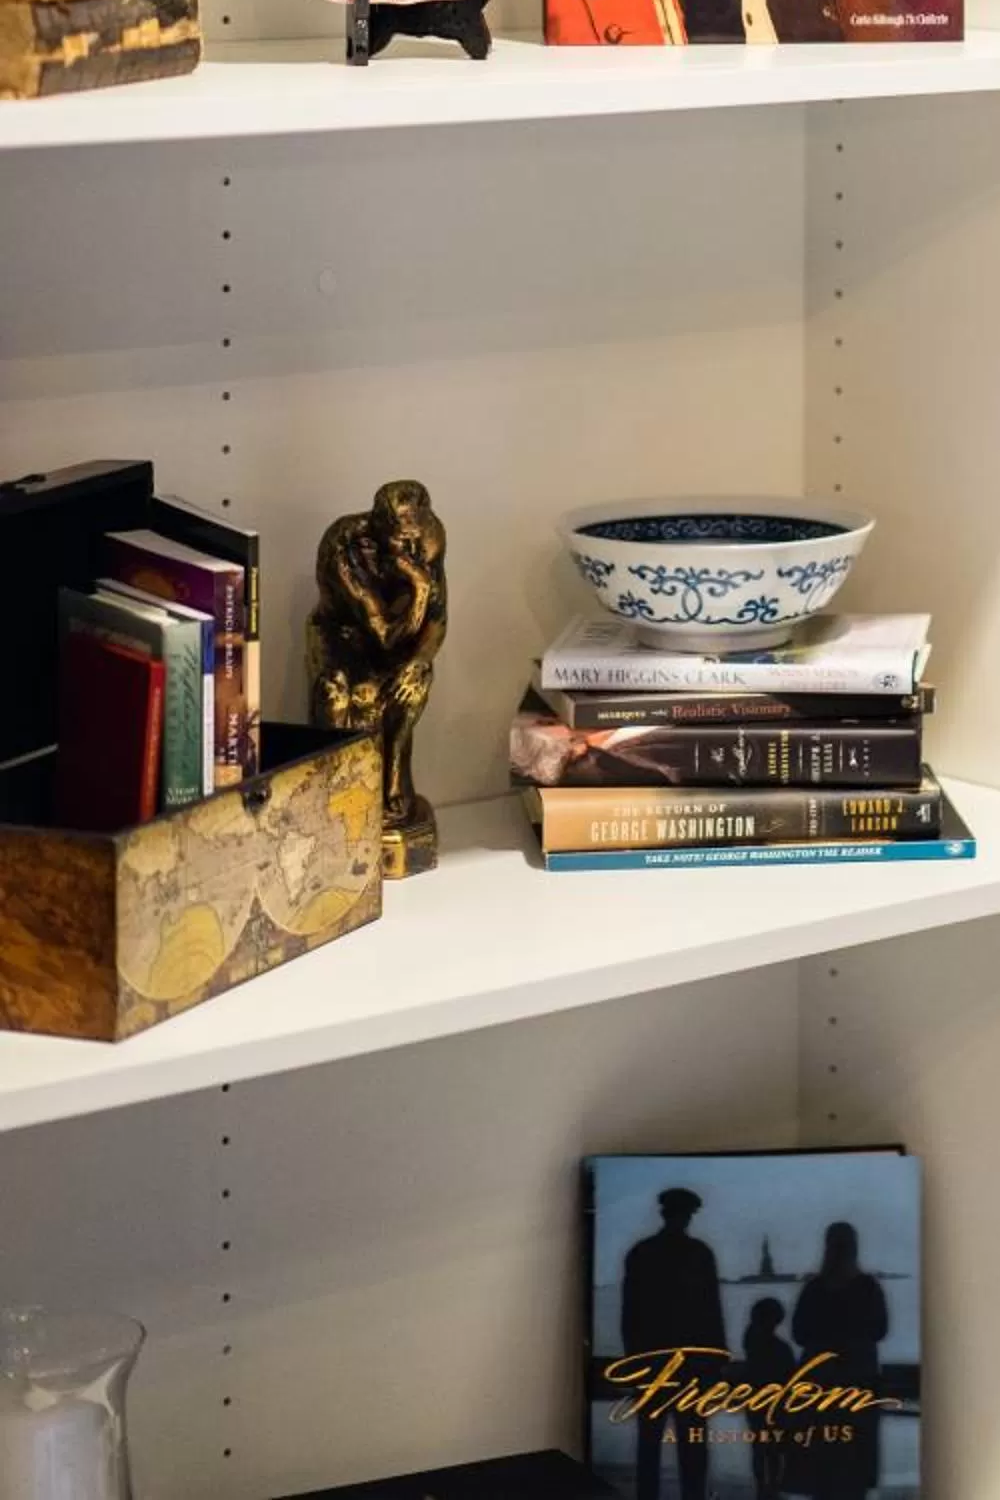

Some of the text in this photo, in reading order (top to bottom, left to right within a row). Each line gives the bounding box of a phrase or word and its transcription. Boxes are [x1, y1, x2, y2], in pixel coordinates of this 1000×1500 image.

[554, 666, 747, 686] MARY HIGGINS CLARK
[671, 704, 727, 719] Realistic
[612, 802, 728, 817] THE RETURN OF
[591, 815, 756, 843] GEORGE WASHINGTON
[644, 853, 671, 865] TAKE
[705, 850, 749, 862] GEORGE
[749, 848, 816, 861] WASHINGTON
[818, 847, 840, 858] THE
[841, 846, 883, 857] READER
[603, 1345, 903, 1426] Freedom
[661, 1427, 677, 1444] A
[793, 1426, 816, 1448] of
[822, 1424, 854, 1443] US
